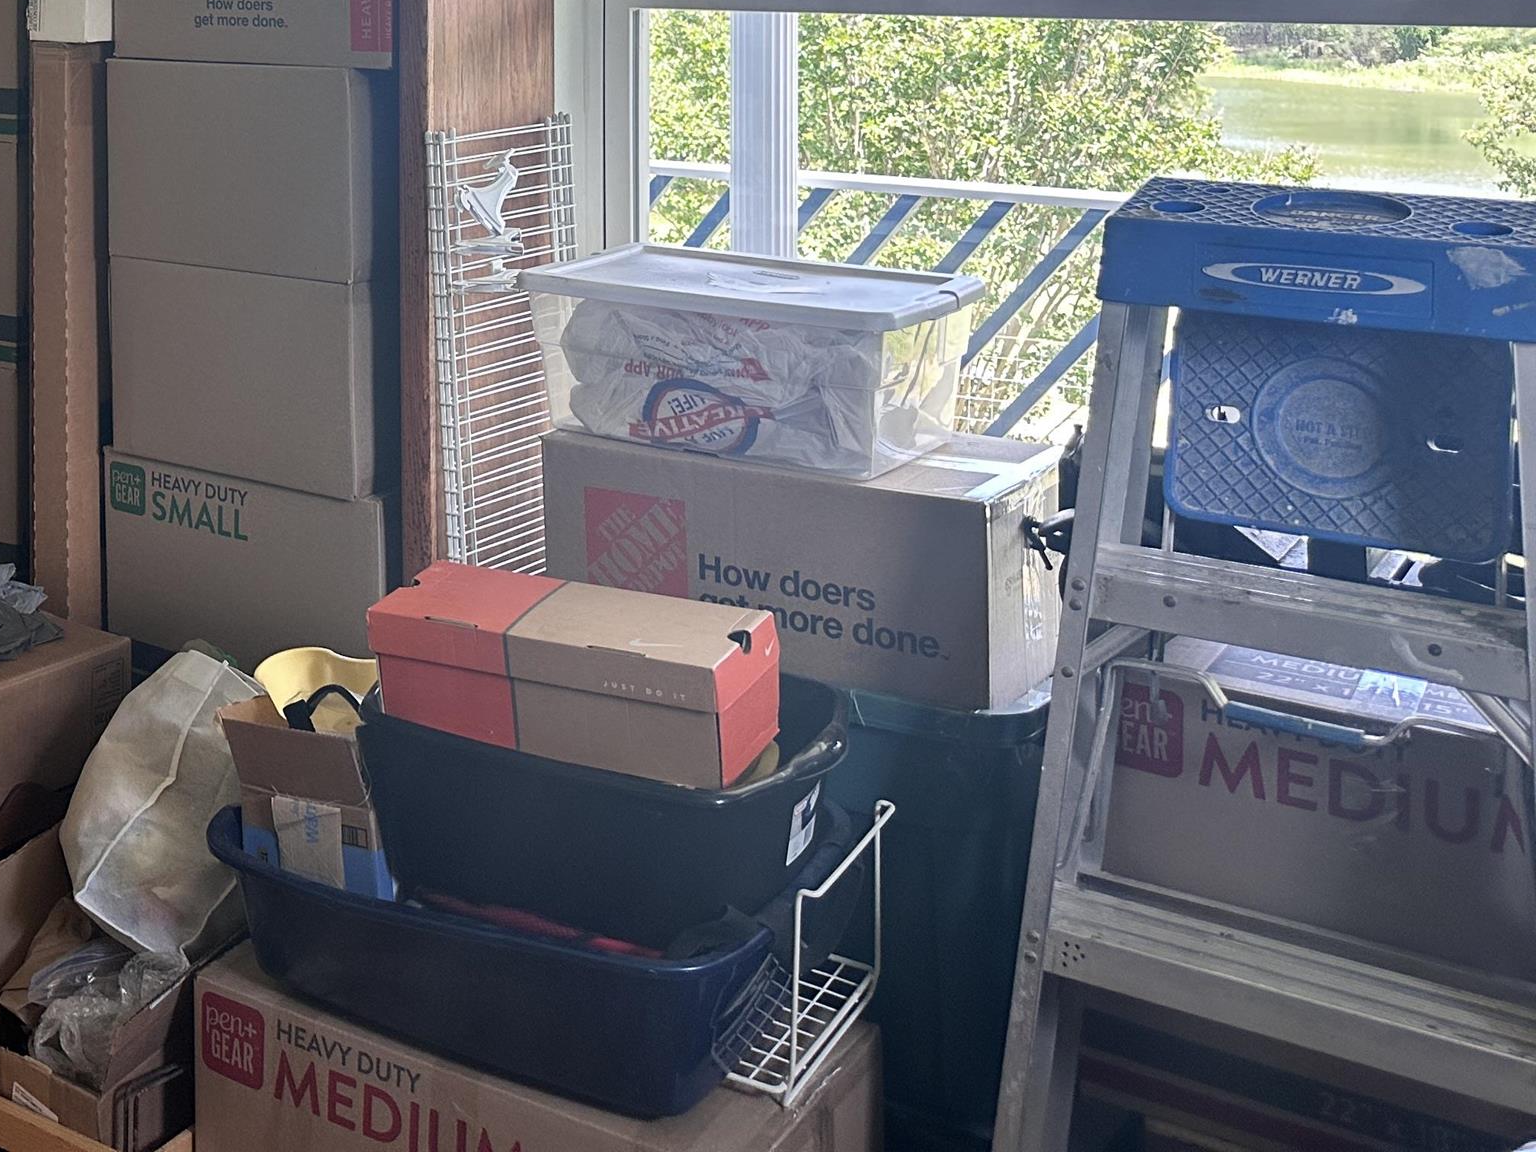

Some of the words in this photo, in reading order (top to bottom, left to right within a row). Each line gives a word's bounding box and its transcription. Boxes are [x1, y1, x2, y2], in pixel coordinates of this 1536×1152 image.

[194, 14, 215, 29] get
[217, 15, 250, 28] more
[252, 14, 289, 28] done.
[1259, 267, 1362, 290] WERNER
[668, 394, 705, 416] LIFE!
[115, 483, 140, 507] GEAR
[151, 471, 202, 496] HEAVY
[205, 483, 248, 506] DUTY
[152, 490, 248, 542] SMALL
[598, 504, 636, 542] THE
[588, 497, 686, 586] HOME
[698, 553, 770, 591] How
[779, 570, 876, 612] doers
[603, 681, 636, 693] JUST
[645, 687, 663, 698] DO
[673, 691, 686, 701] IT
[1122, 721, 1168, 762] EAR
[210, 1028, 255, 1075] GEAR
[276, 1018, 353, 1067] HEAVY
[357, 1050, 421, 1094] DUTY
